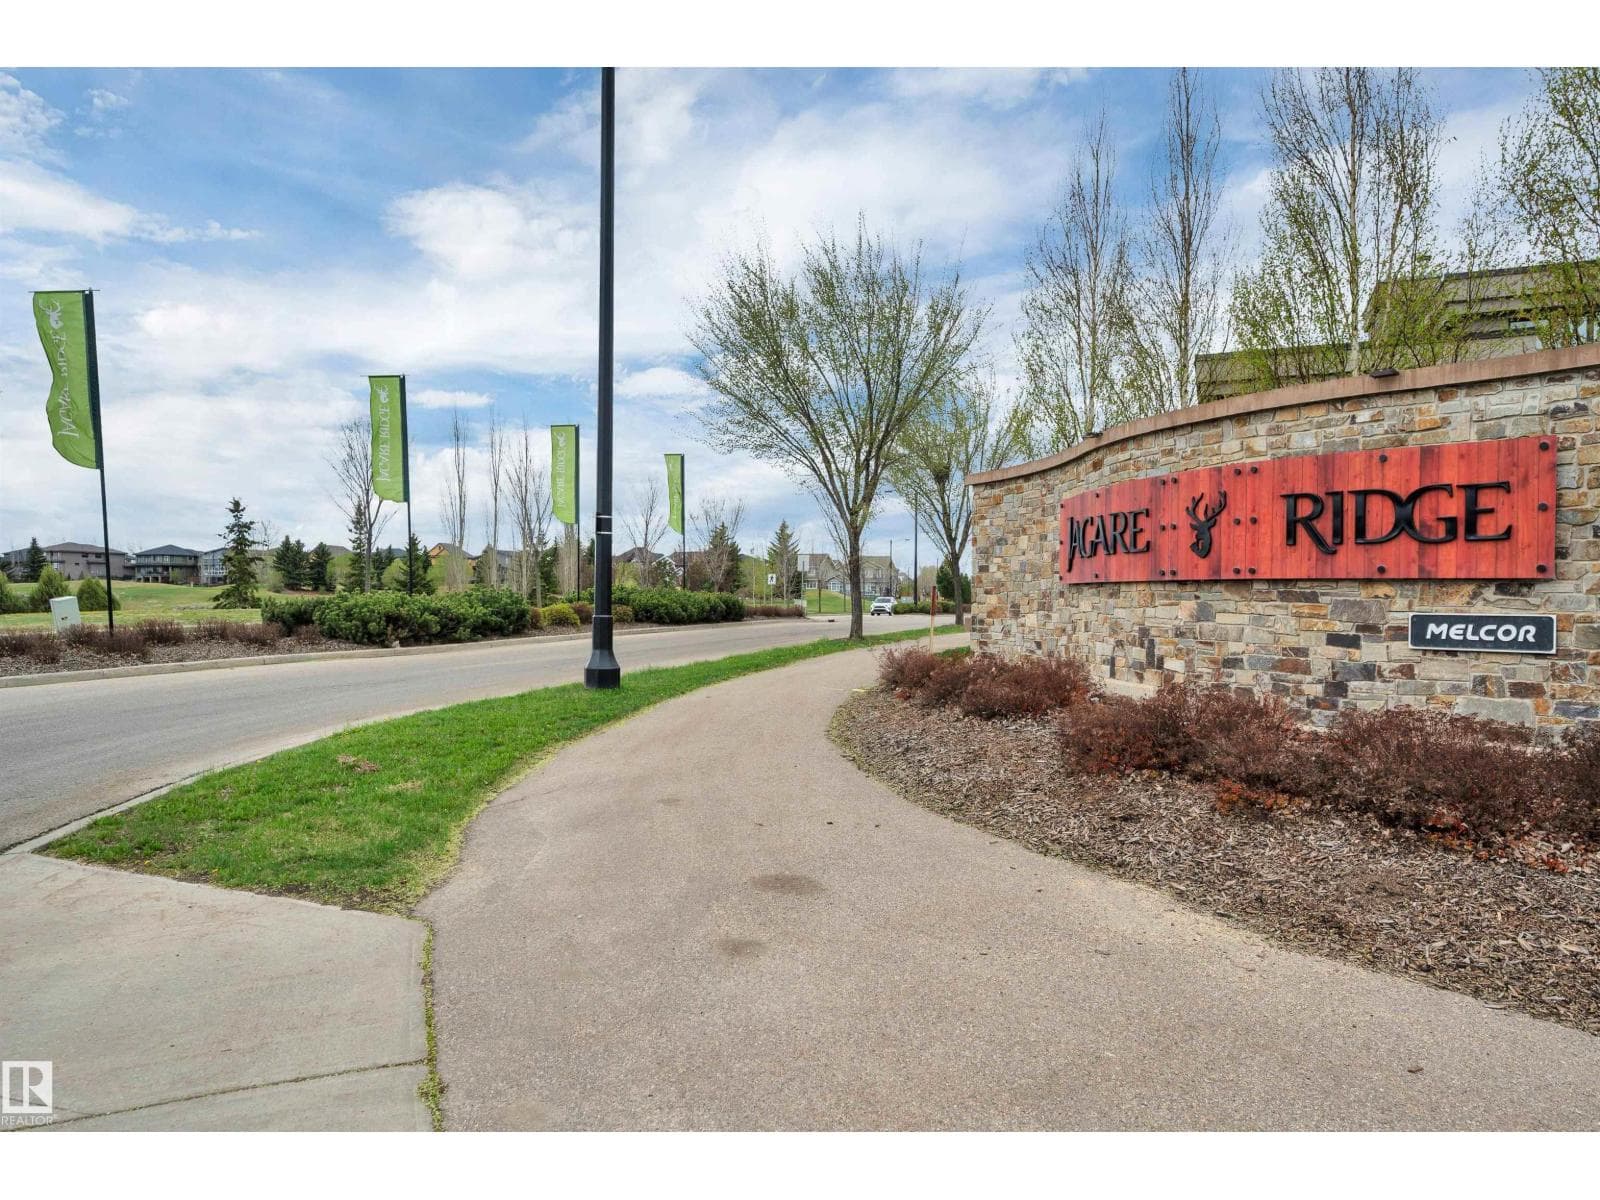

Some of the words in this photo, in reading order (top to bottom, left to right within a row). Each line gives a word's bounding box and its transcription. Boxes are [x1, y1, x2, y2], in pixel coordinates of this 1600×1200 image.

[1067, 508, 1151, 573] JAGARE
[1280, 481, 1512, 554] RIDGE
[1425, 623, 1537, 642] MELCOR
